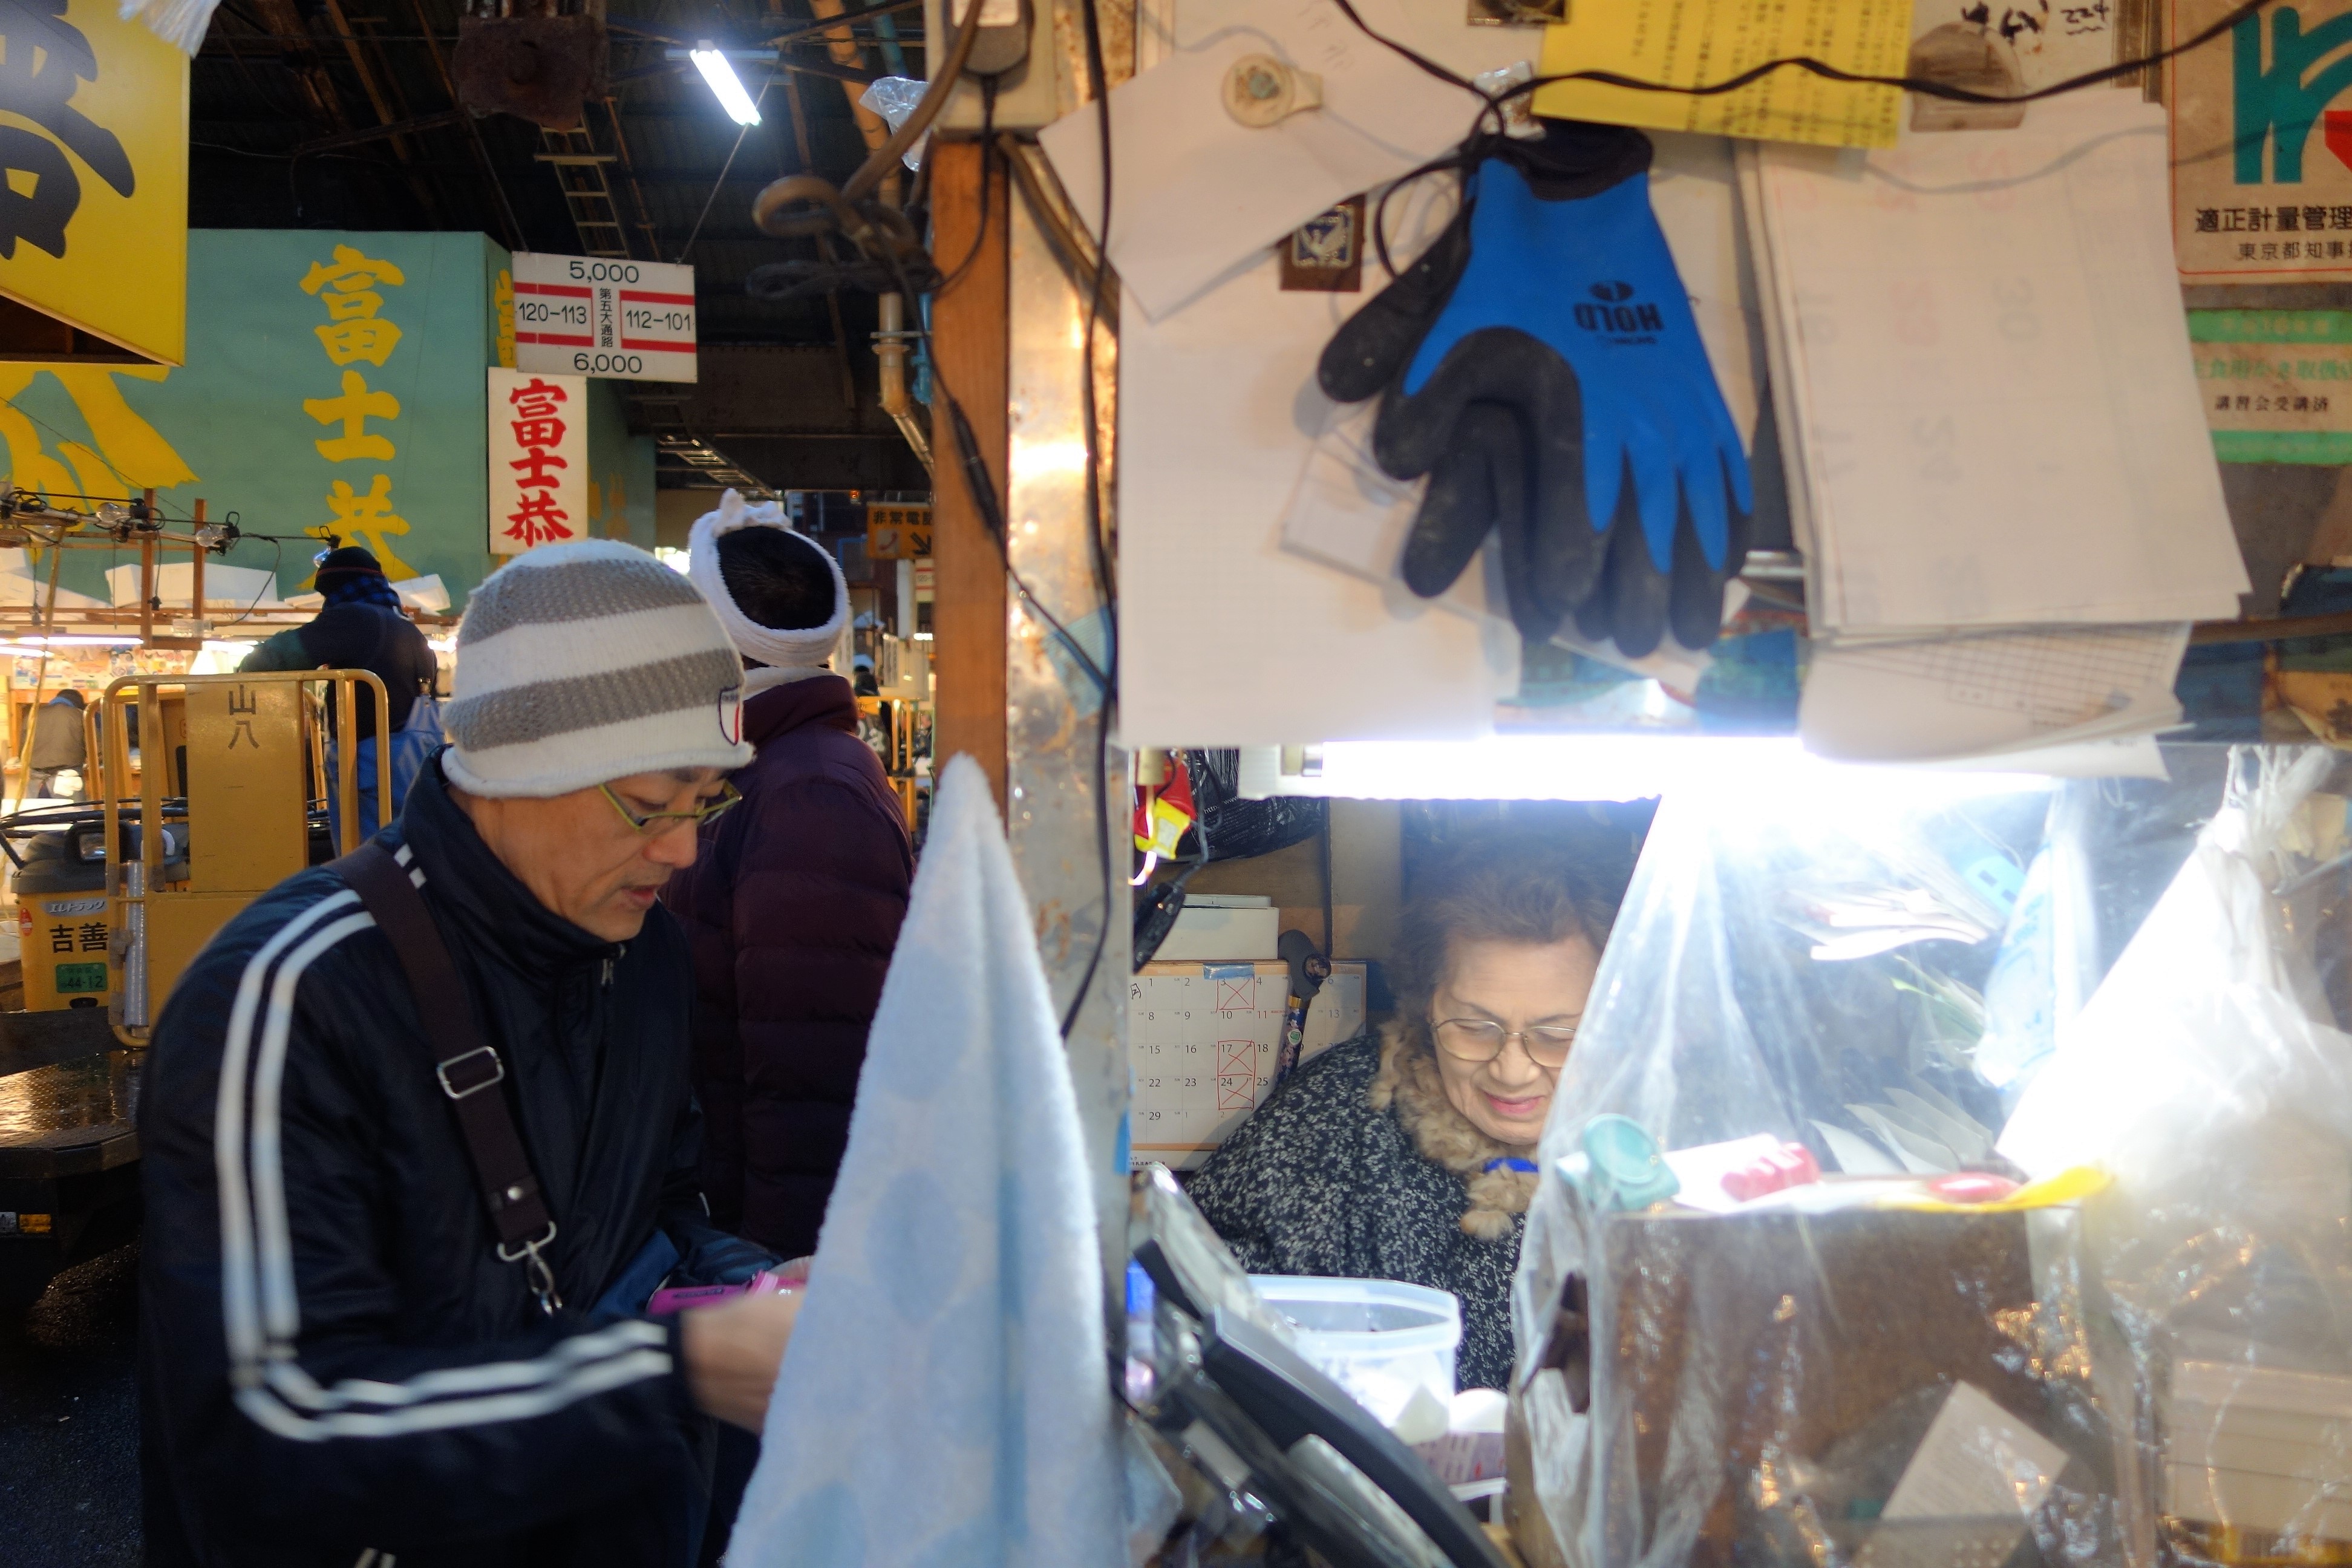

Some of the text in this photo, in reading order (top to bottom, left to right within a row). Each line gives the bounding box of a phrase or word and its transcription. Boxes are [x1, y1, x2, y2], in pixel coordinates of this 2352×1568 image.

[2236, 241, 2352, 261] 東京都知事
[569, 260, 640, 284] 5,000
[518, 302, 587, 324] 120-113
[599, 287, 613, 348] 第五大通路
[626, 310, 691, 332] 112-101
[1573, 302, 1664, 333] HOLD
[573, 352, 642, 374] 6,000
[500, 377, 574, 548] 富士恭
[228, 684, 261, 750] 山八
[49, 921, 108, 953] 吉善
[1149, 978, 1153, 987] 1
[1184, 977, 1191, 987] 2
[1256, 976, 1263, 985] 4
[1148, 1011, 1154, 1021] 8
[1184, 1011, 1191, 1020] 9
[1221, 1010, 1233, 1020] 10
[1257, 1010, 1267, 1019] 11
[1149, 1044, 1269, 1054] 15 16 17 18
[1149, 1077, 1269, 1088] 22 23 24 25
[1149, 1111, 1161, 1120] 29
